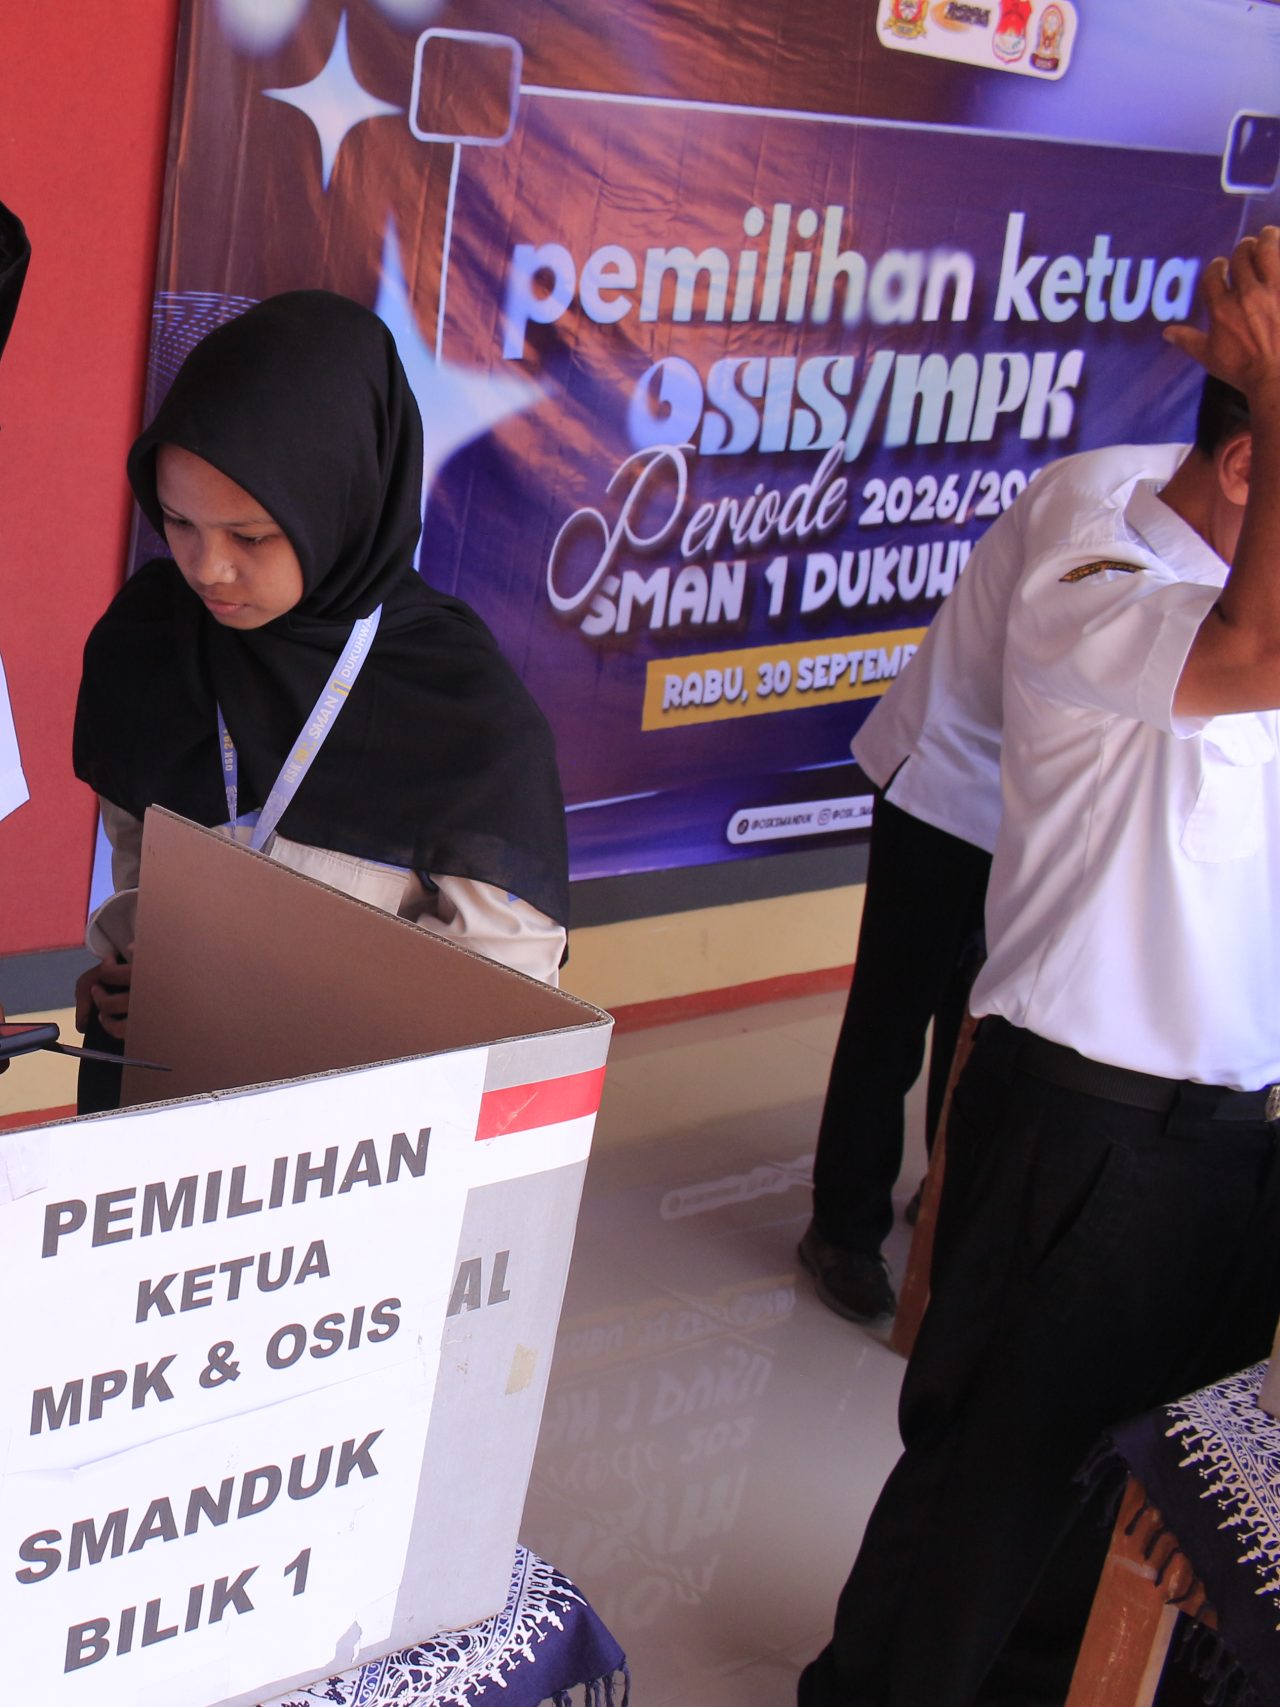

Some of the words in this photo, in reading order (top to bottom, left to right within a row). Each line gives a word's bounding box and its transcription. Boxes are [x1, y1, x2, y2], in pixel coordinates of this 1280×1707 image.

[503, 203, 975, 360] pemilihan
[993, 212, 1200, 323] ketua
[628, 350, 1084, 463] OSIS/MPK
[547, 440, 848, 612] Periode
[859, 468, 1044, 525] 2026/20
[580, 560, 746, 636] SMAN
[765, 556, 788, 616] 1
[283, 764, 303, 784] OSK
[329, 679, 353, 697] 1
[662, 666, 749, 710] RABU,
[756, 661, 792, 698] 30
[224, 752, 234, 772] OSK
[41, 1127, 433, 1258] PEMILIHAN
[135, 1240, 331, 1323] KETUA
[29, 1356, 175, 1436] MPK
[199, 1340, 241, 1389] &
[265, 1298, 402, 1370] OSIS
[15, 1429, 386, 1584] SMANDUK
[64, 1566, 259, 1673] BILIK
[282, 1547, 312, 1598] 1
